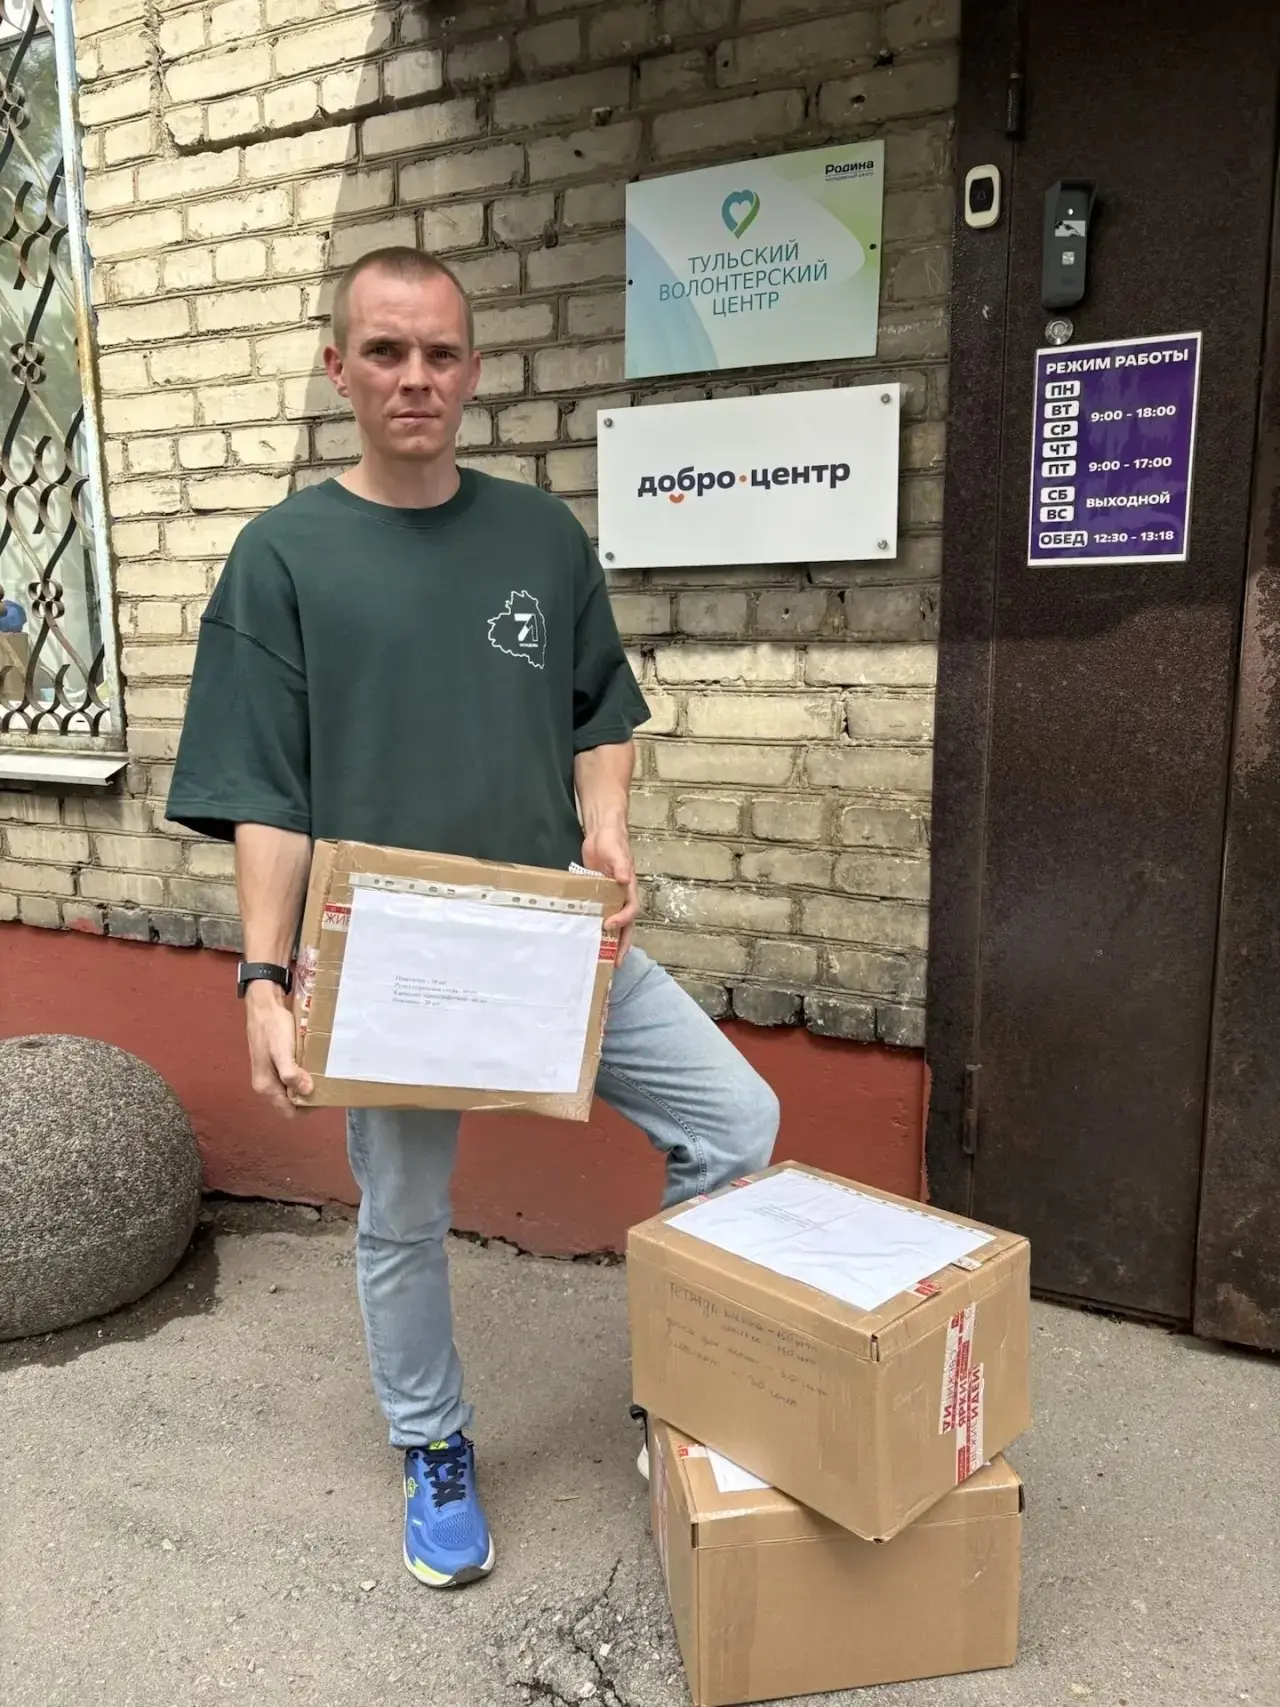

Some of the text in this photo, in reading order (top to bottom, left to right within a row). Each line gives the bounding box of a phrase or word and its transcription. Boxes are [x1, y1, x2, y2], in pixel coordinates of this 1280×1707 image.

[825, 160, 874, 175] Родина
[688, 239, 799, 275] ТУЛЬСКИЙ
[659, 259, 828, 301] ВОЛОНТЕРСКИЙ
[713, 291, 780, 318] ЦЕНТР
[1045, 348, 1189, 375] РЕЖИМ РАБОТЫ
[1050, 382, 1075, 397] ПН
[1051, 403, 1073, 416] ВТ
[1090, 410, 1123, 422] 9:00
[1135, 405, 1176, 418] 18:00
[1050, 423, 1072, 437] СР
[1049, 443, 1071, 455] ЧТ
[1047, 463, 1070, 476] ПТ
[1088, 461, 1121, 472] 9:00
[1133, 456, 1172, 469] 17:00
[638, 462, 850, 497] добро центр
[1047, 488, 1068, 501] СБ
[1085, 491, 1171, 508] ВЫХОДНОЙ
[1046, 508, 1067, 520] ВС
[1040, 532, 1086, 547] ОБЕД
[1093, 532, 1128, 543] 12:30
[1140, 530, 1174, 542] 13:18
